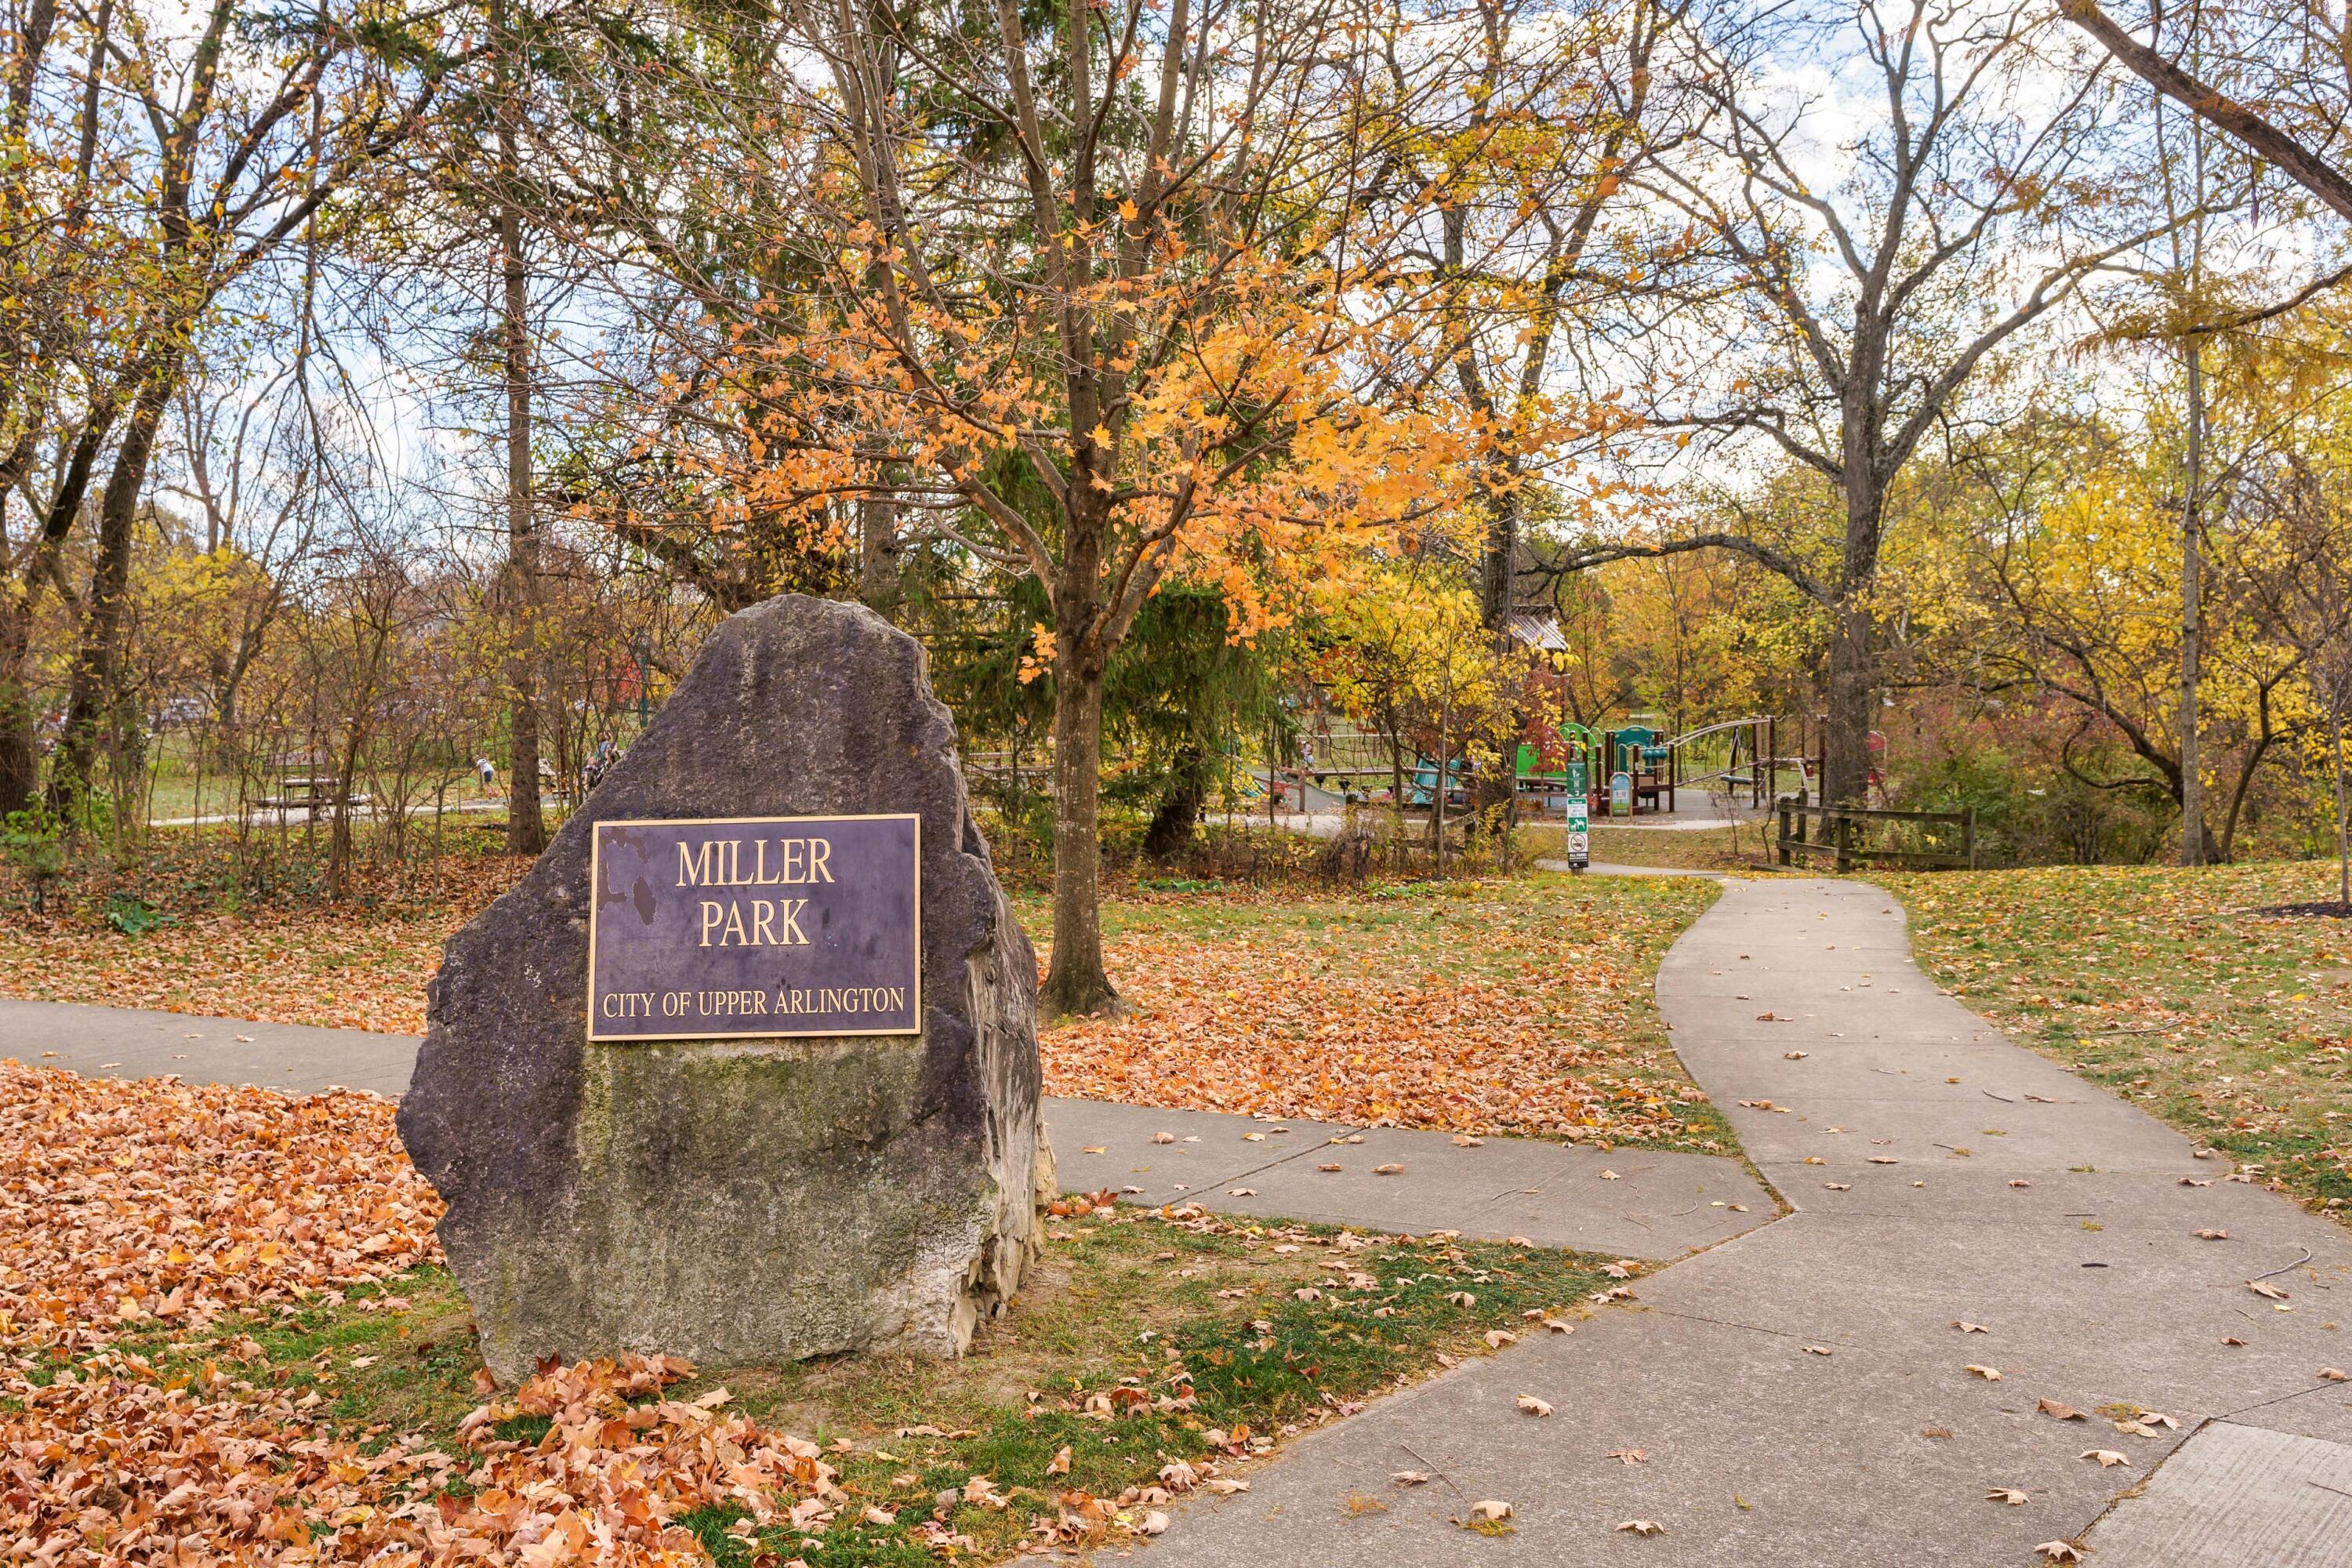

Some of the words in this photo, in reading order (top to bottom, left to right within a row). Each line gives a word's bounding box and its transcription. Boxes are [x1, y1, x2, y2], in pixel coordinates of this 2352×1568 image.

[676, 838, 836, 887] MILLER
[699, 898, 811, 948] PARK
[603, 993, 656, 1018] CITY
[662, 991, 691, 1017] OF
[699, 990, 768, 1016] UPPER
[774, 987, 906, 1014] ARLINGTON
